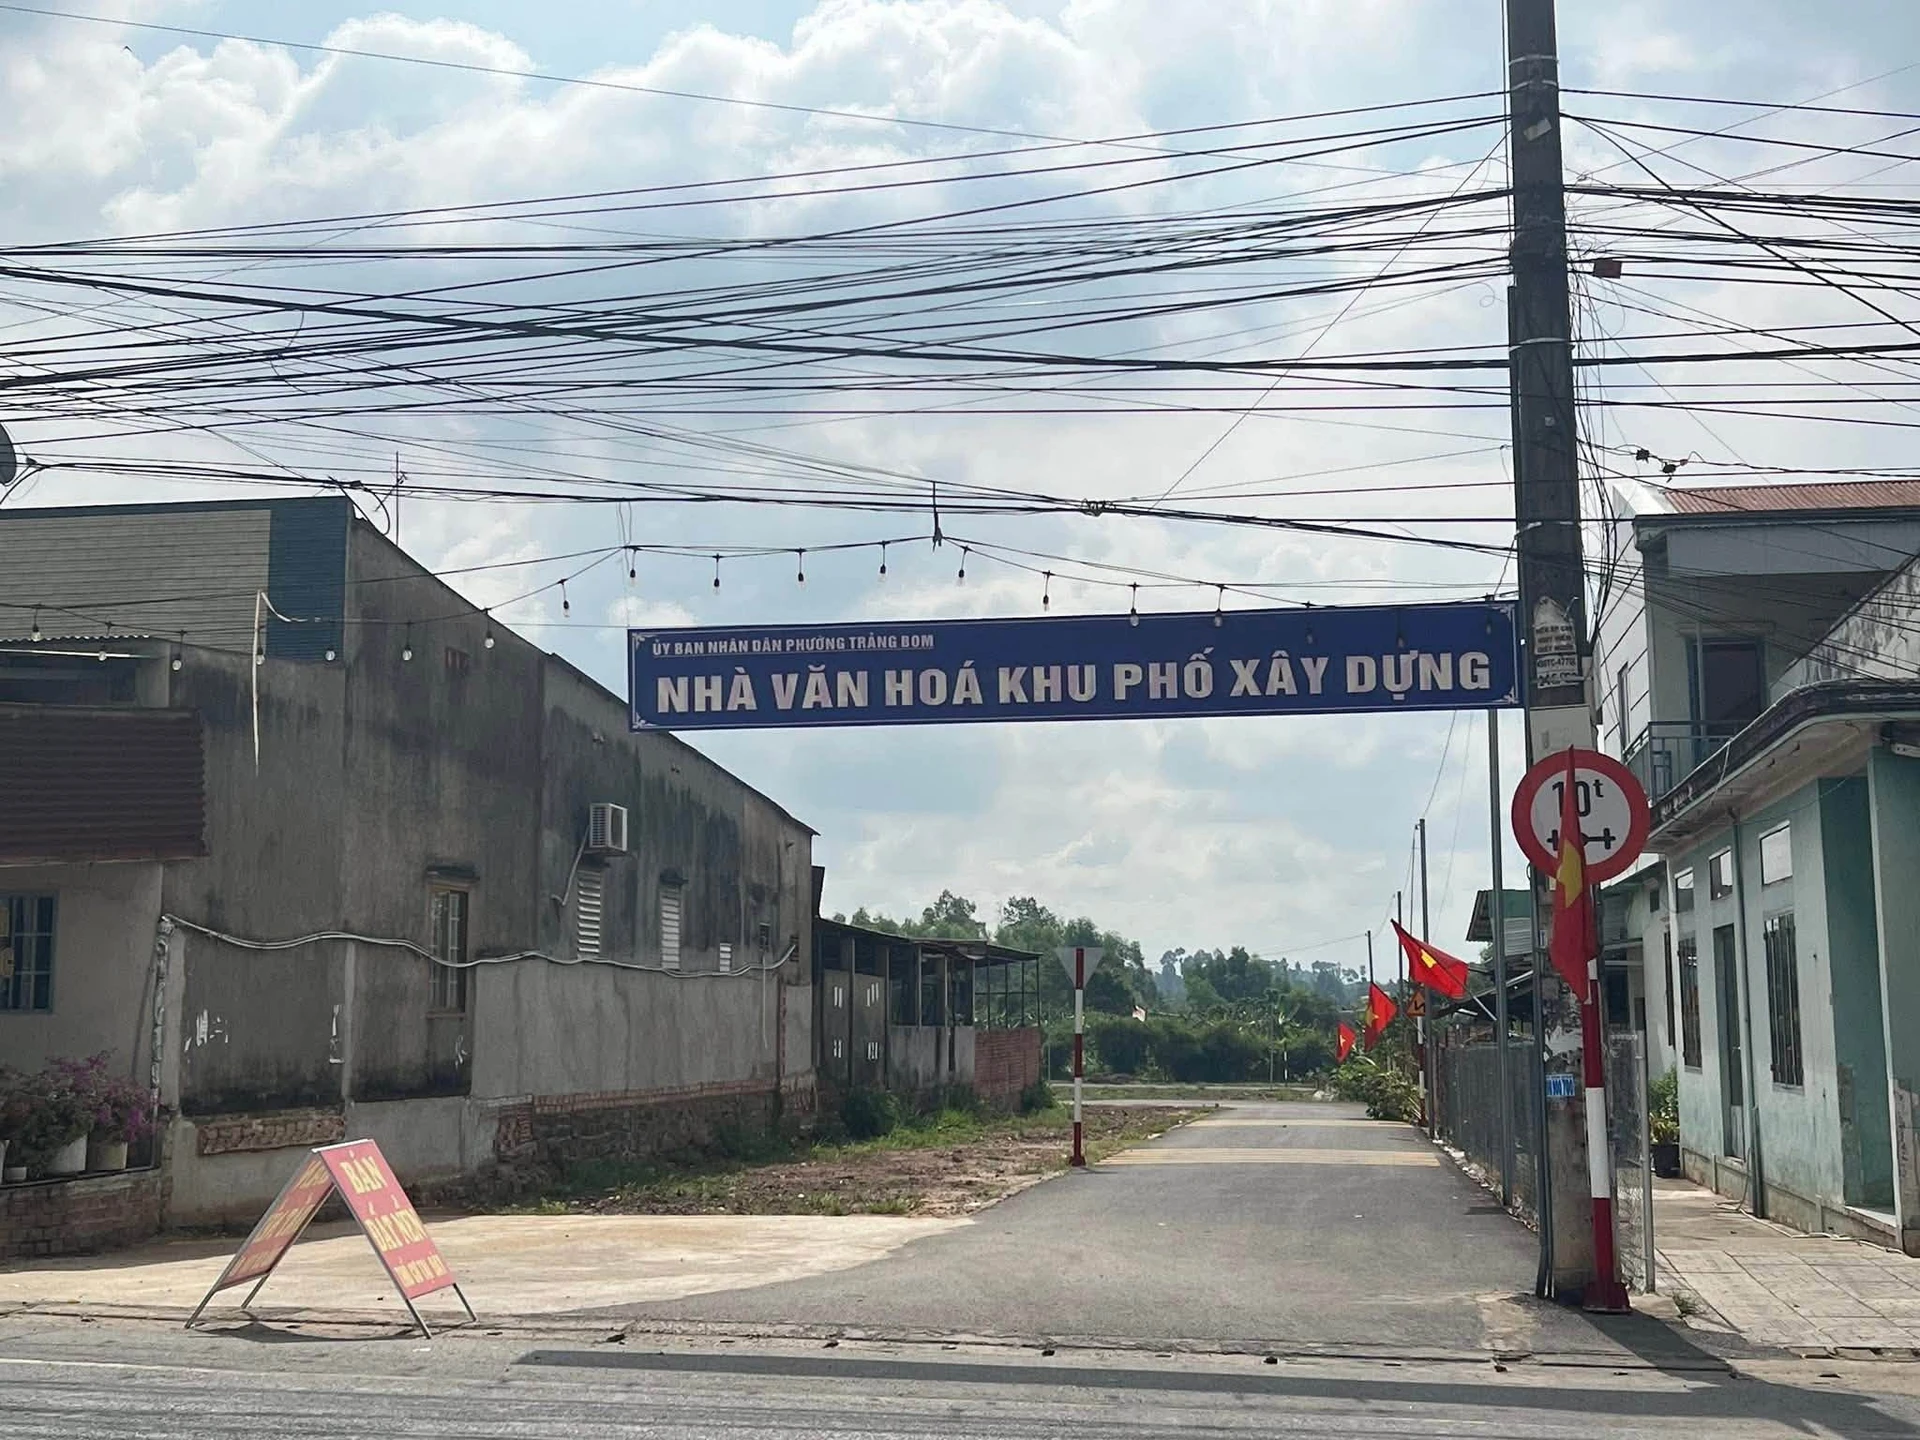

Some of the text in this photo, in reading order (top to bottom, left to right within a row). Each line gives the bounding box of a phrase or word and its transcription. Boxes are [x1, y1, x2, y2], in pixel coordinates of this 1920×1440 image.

[652, 631, 934, 655] ỦY BAN NHÂN DÂN PHƯỜNG TRẢNG BOM
[657, 647, 1490, 713] NHÀ VĂN HOÁ KHU PHỐ XÂY DỰNG
[338, 1149, 387, 1194] BÁN
